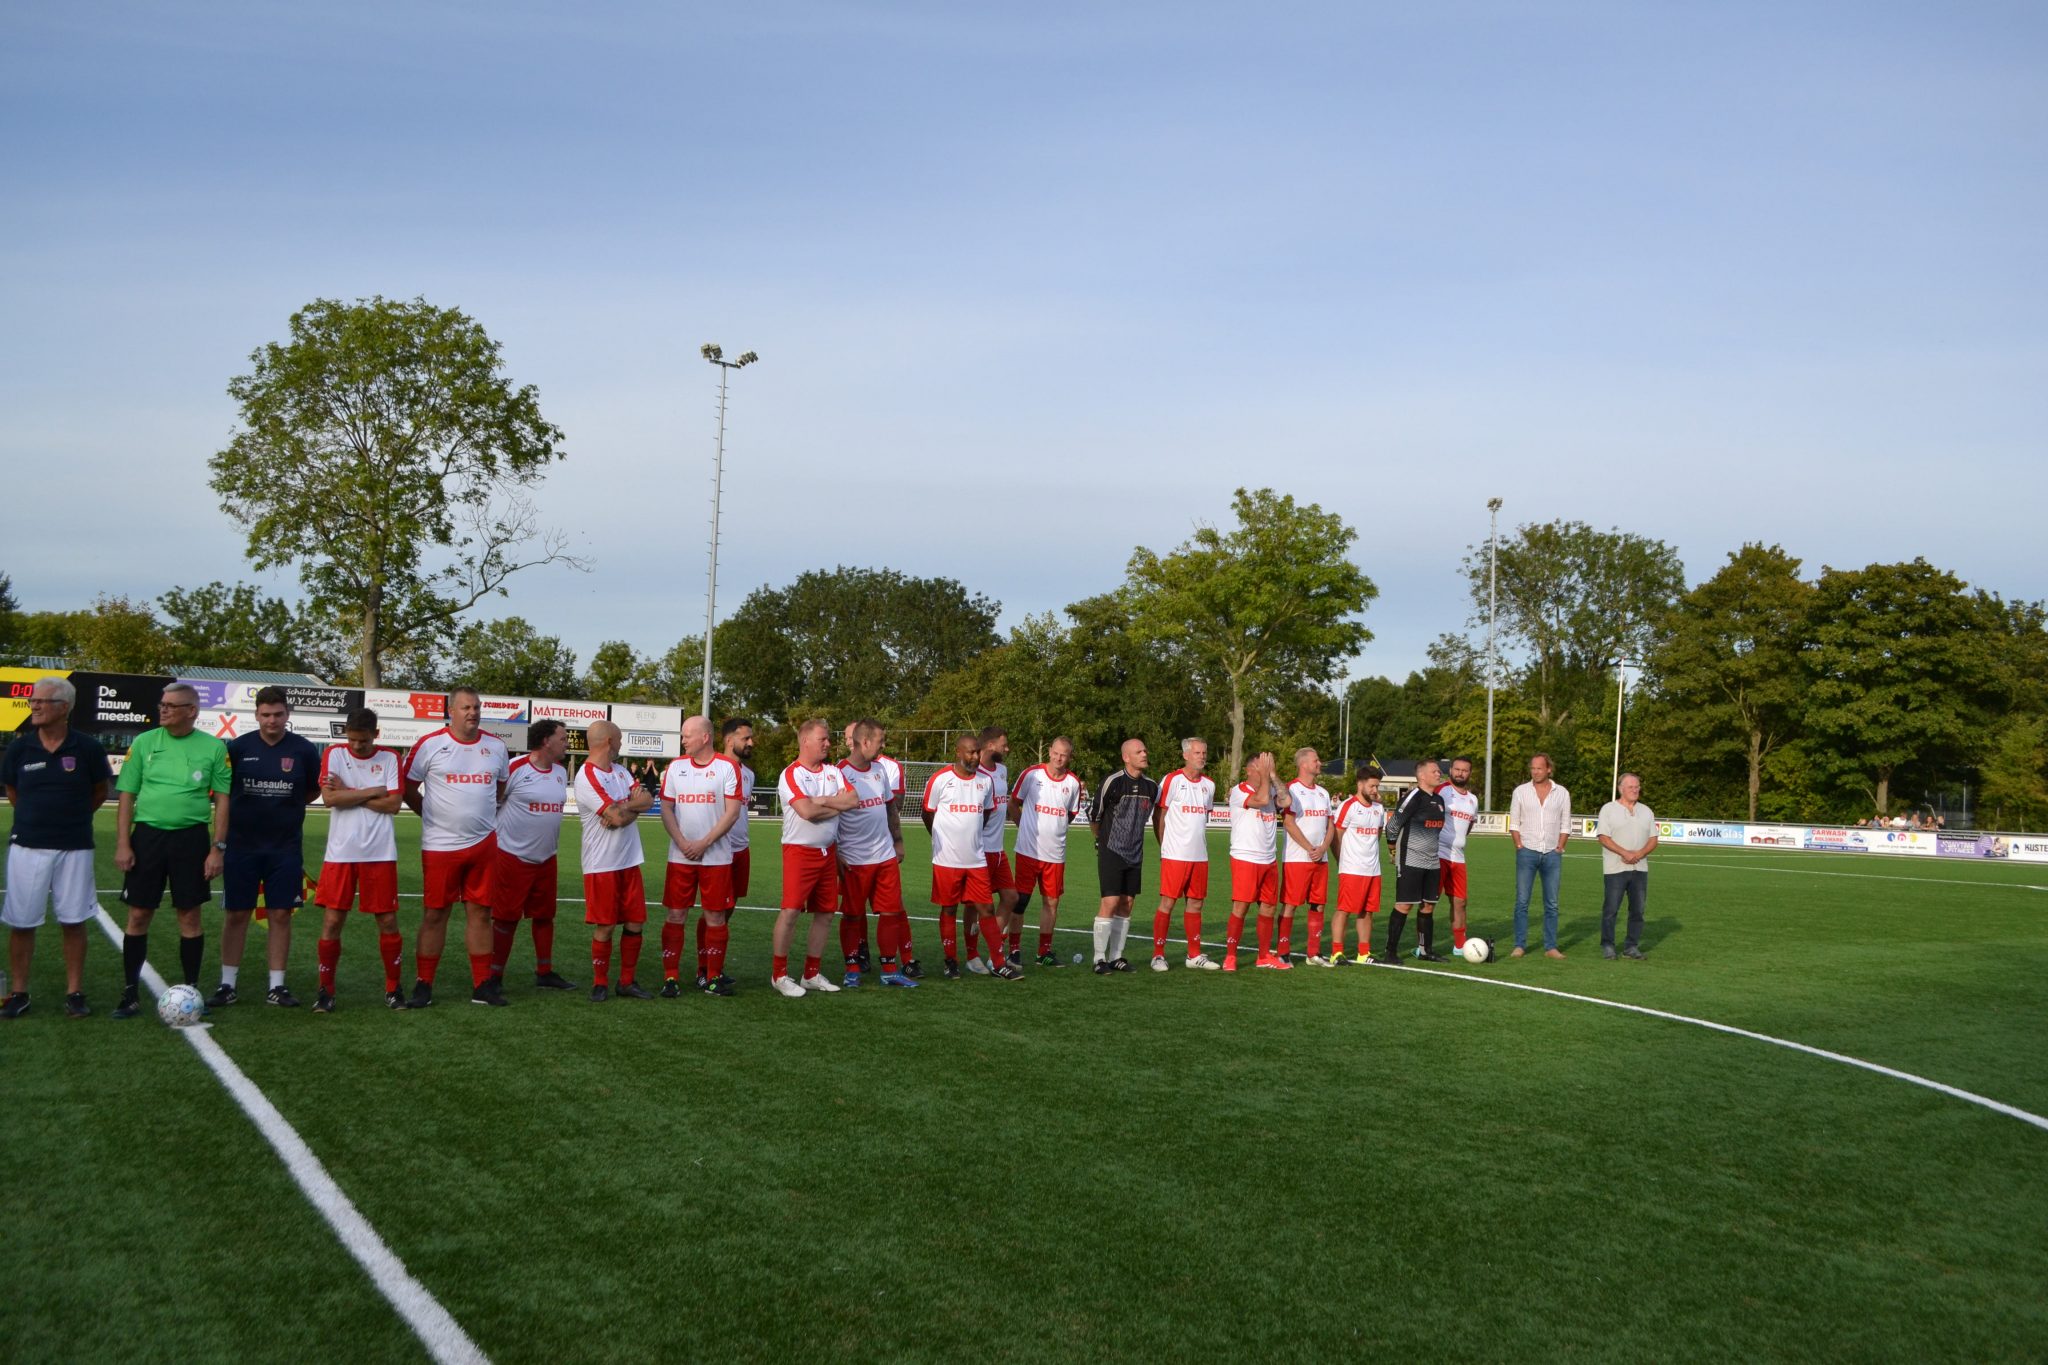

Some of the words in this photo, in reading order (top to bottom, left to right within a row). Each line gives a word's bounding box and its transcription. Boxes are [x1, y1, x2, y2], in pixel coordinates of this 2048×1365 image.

[98, 685, 118, 698] De
[286, 688, 347, 700] Schildersbedrijf
[97, 697, 132, 710] bouw
[97, 712, 151, 723] meester.
[533, 706, 606, 719] MATTERHORN
[631, 735, 662, 746] TERPSTRA
[251, 778, 295, 790] Lasaulec
[1811, 829, 1847, 837] CARWASH
